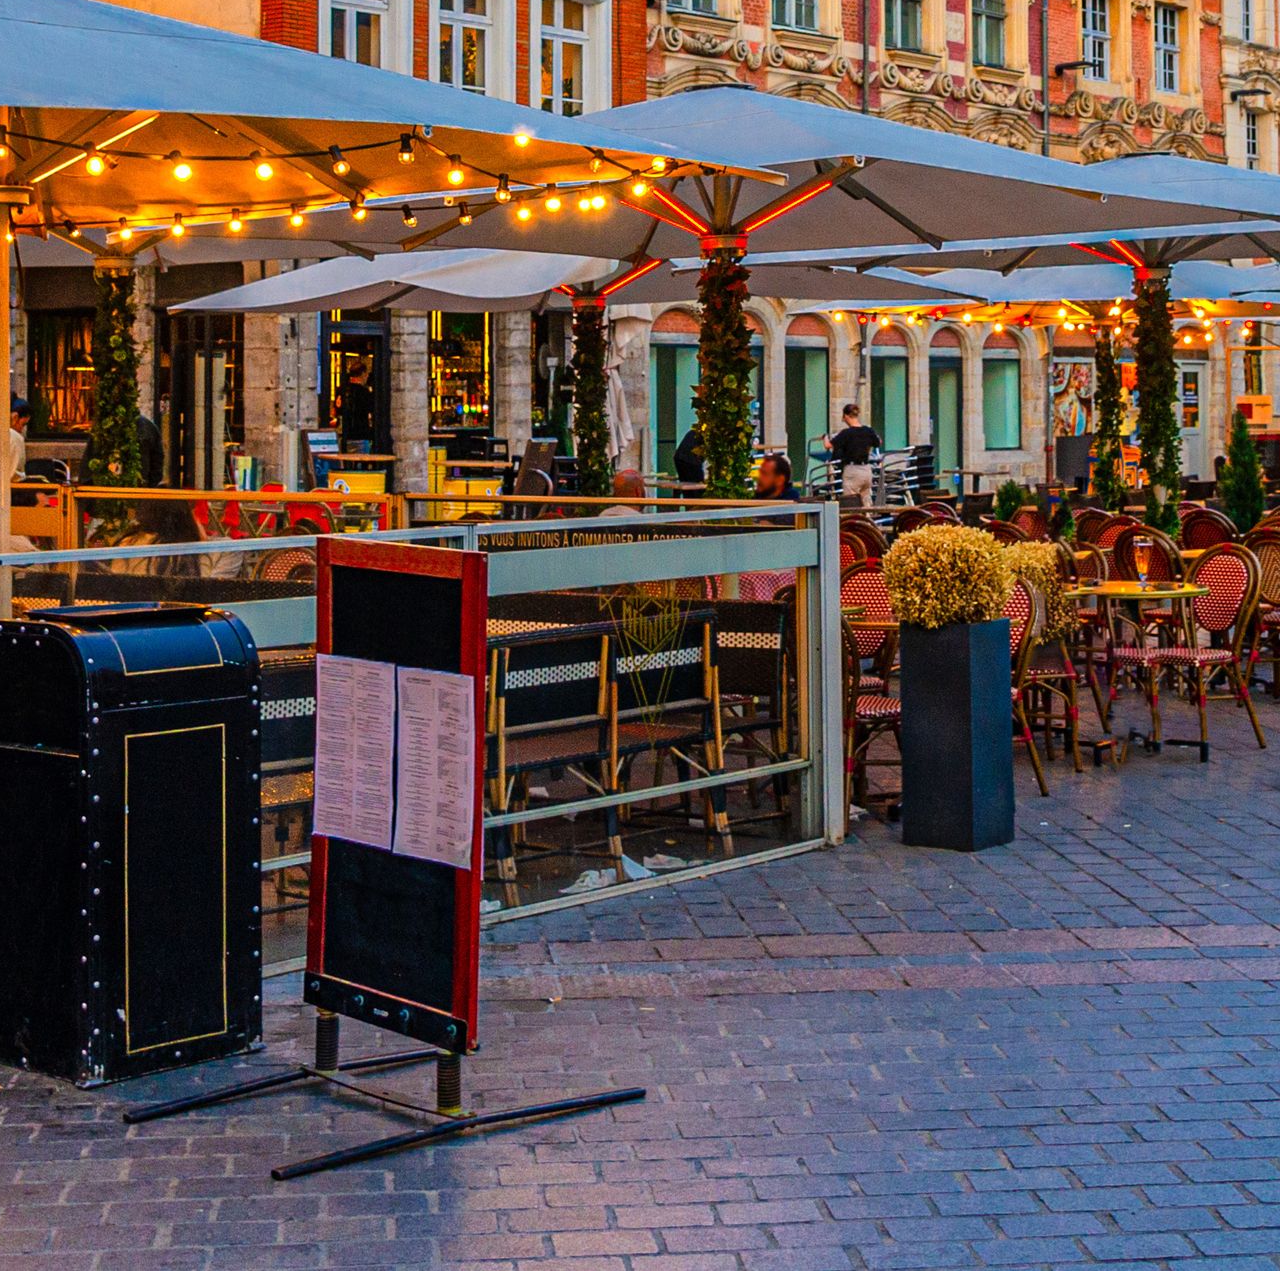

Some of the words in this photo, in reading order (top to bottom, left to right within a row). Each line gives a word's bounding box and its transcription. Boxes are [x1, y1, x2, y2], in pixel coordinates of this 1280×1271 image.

[491, 532, 515, 547] VOUS
[518, 532, 560, 548] INVITONS
[563, 530, 569, 548] À
[571, 532, 633, 547] COMMANDER
